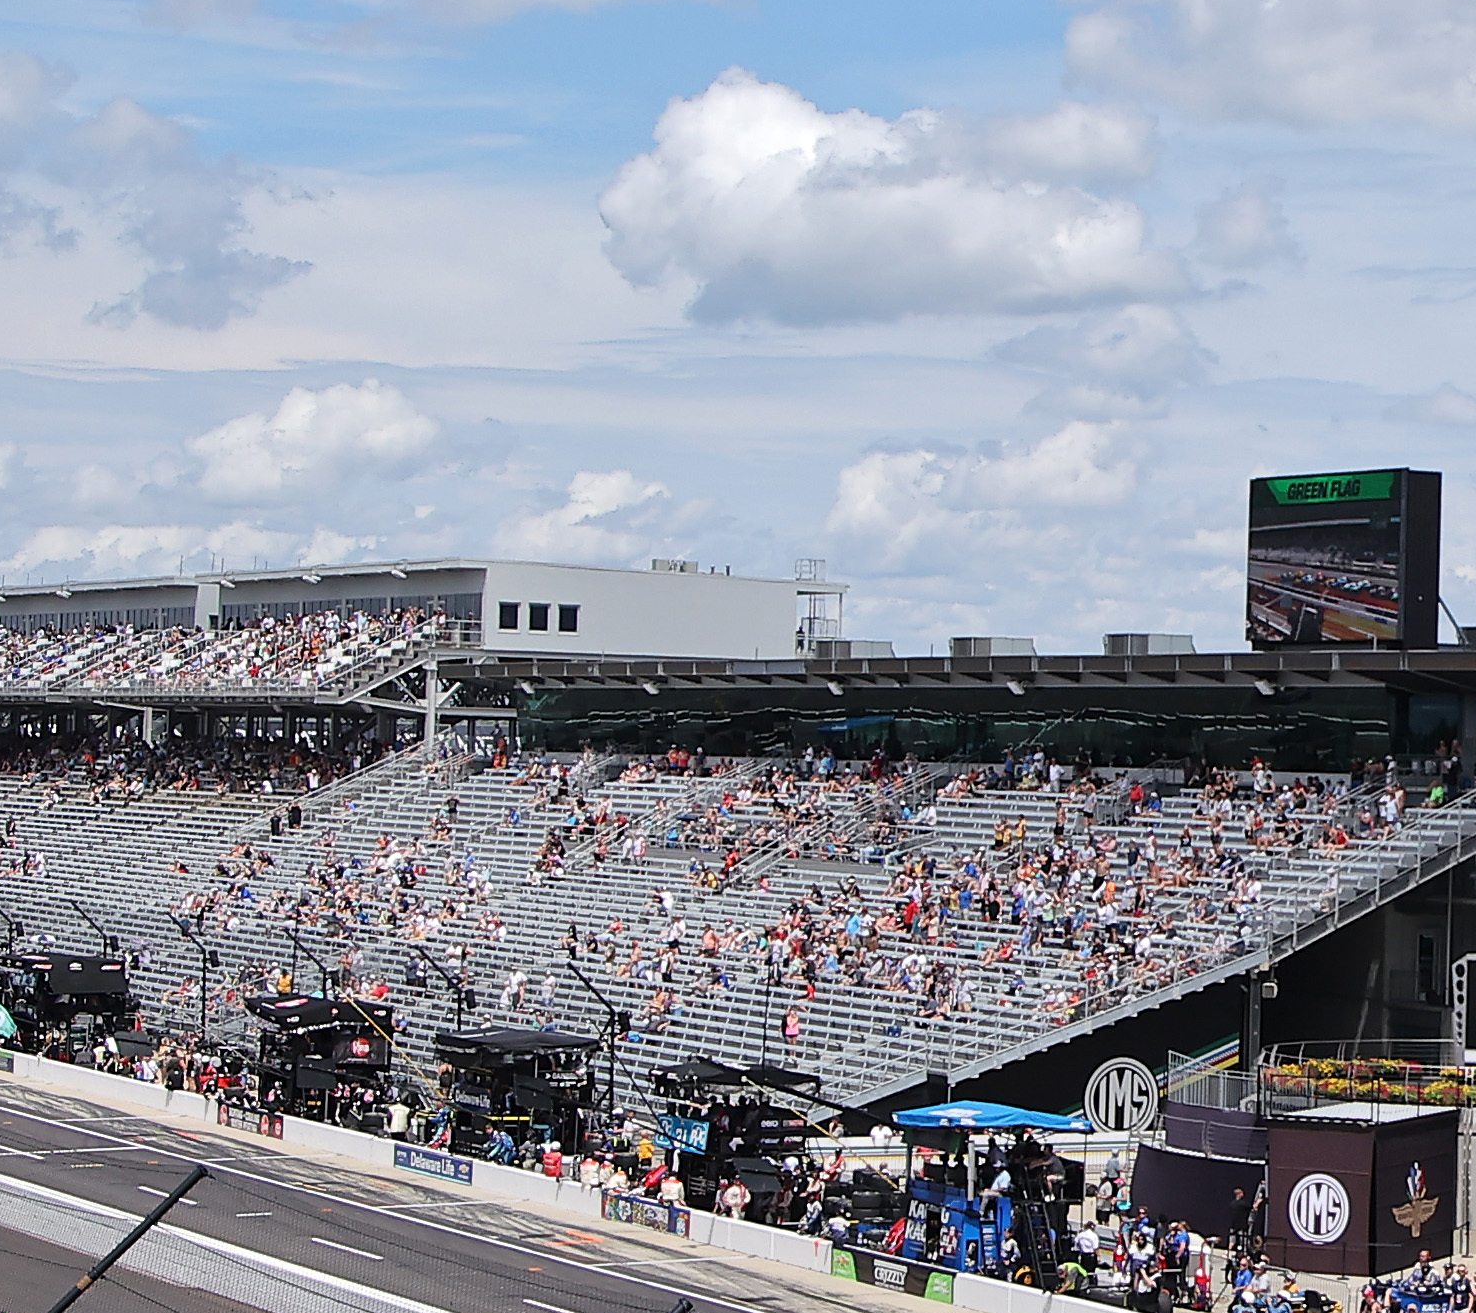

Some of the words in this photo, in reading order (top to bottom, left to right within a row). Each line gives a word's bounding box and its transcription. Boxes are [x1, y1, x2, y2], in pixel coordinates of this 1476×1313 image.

[1287, 481, 1329, 500] GREEN
[1330, 478, 1361, 499] FLAG
[1099, 1070, 1148, 1128] IMS
[410, 1151, 440, 1174] Delaware
[440, 1158, 455, 1176] Life
[1299, 1184, 1342, 1234] IMS
